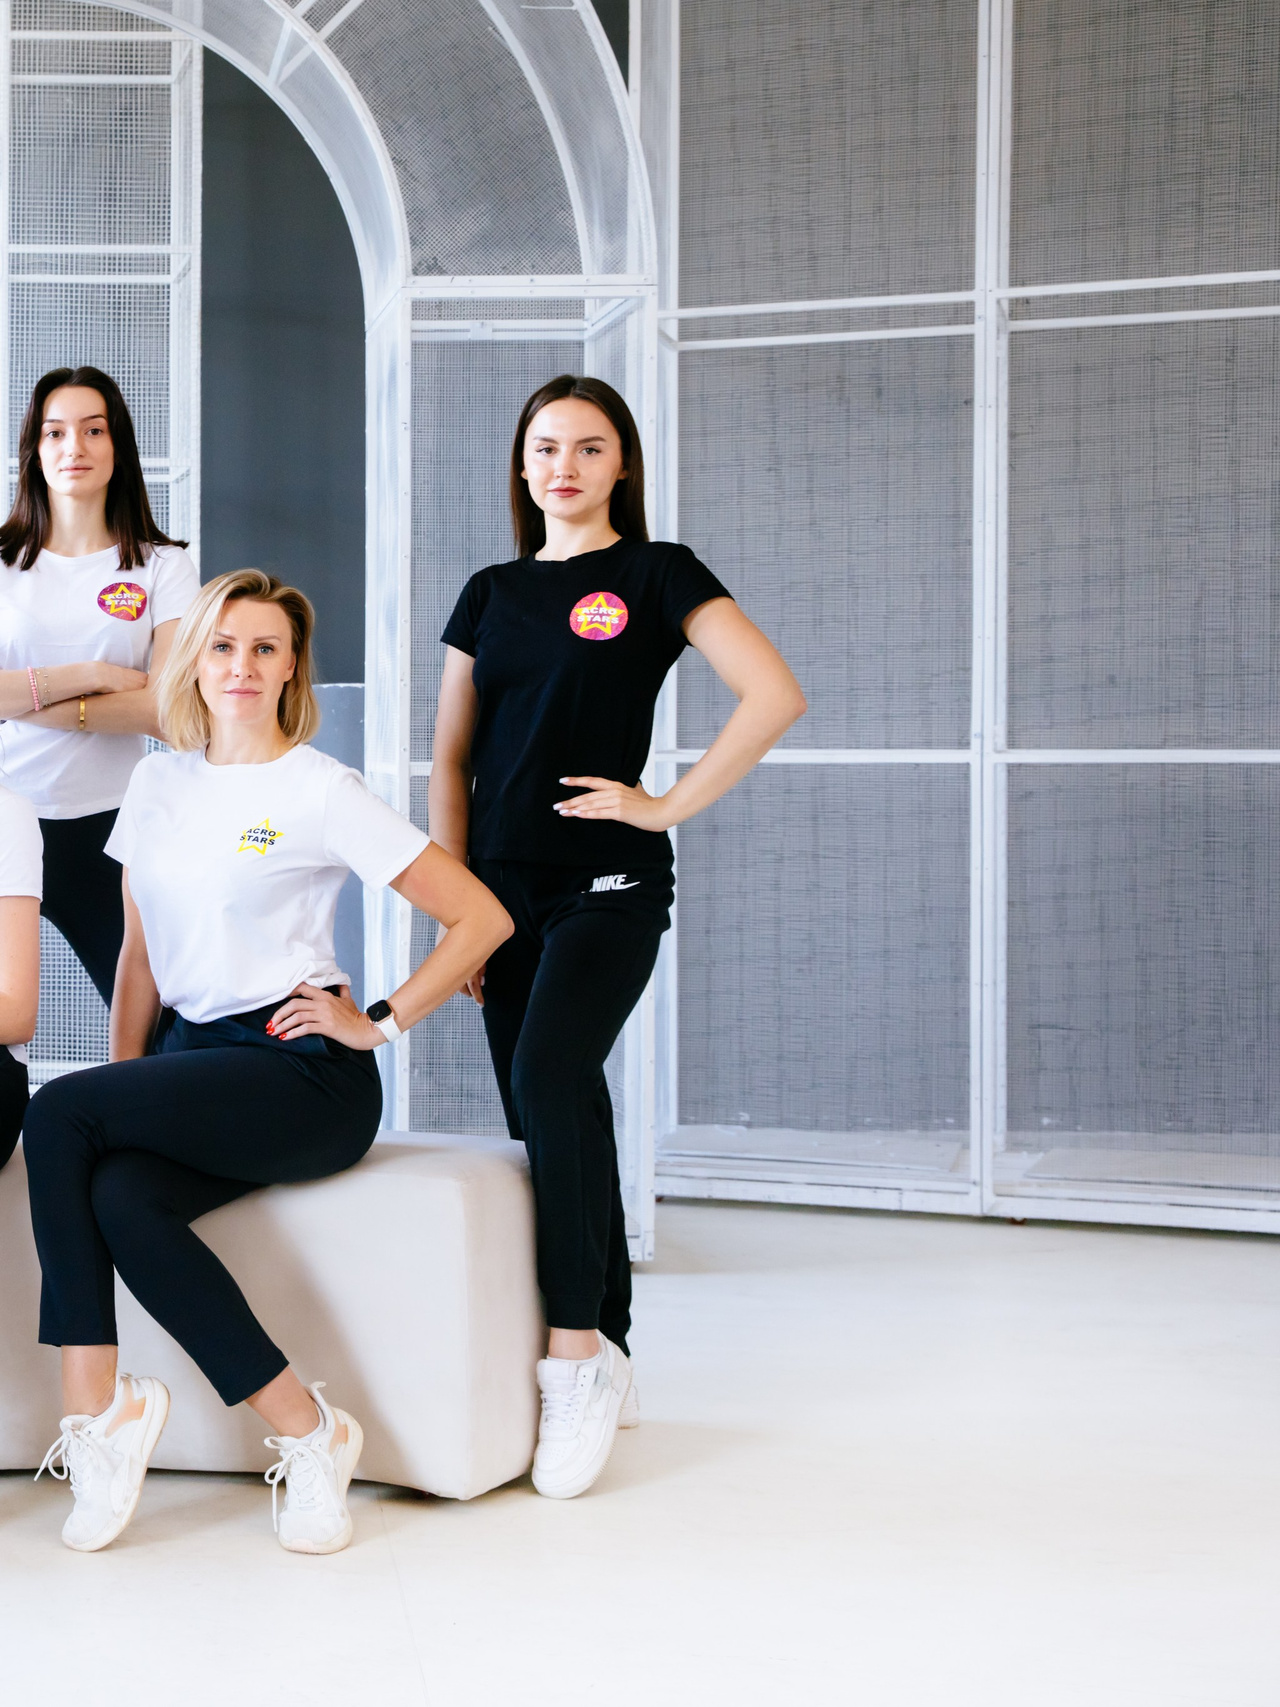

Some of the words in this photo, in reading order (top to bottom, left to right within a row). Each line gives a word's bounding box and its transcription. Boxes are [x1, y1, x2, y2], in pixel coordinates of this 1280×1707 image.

[582, 607, 617, 615] ACRO
[577, 614, 619, 624] STARS
[246, 828, 277, 837] ACRO
[239, 834, 276, 846] STARS
[591, 874, 627, 892] NIKE
